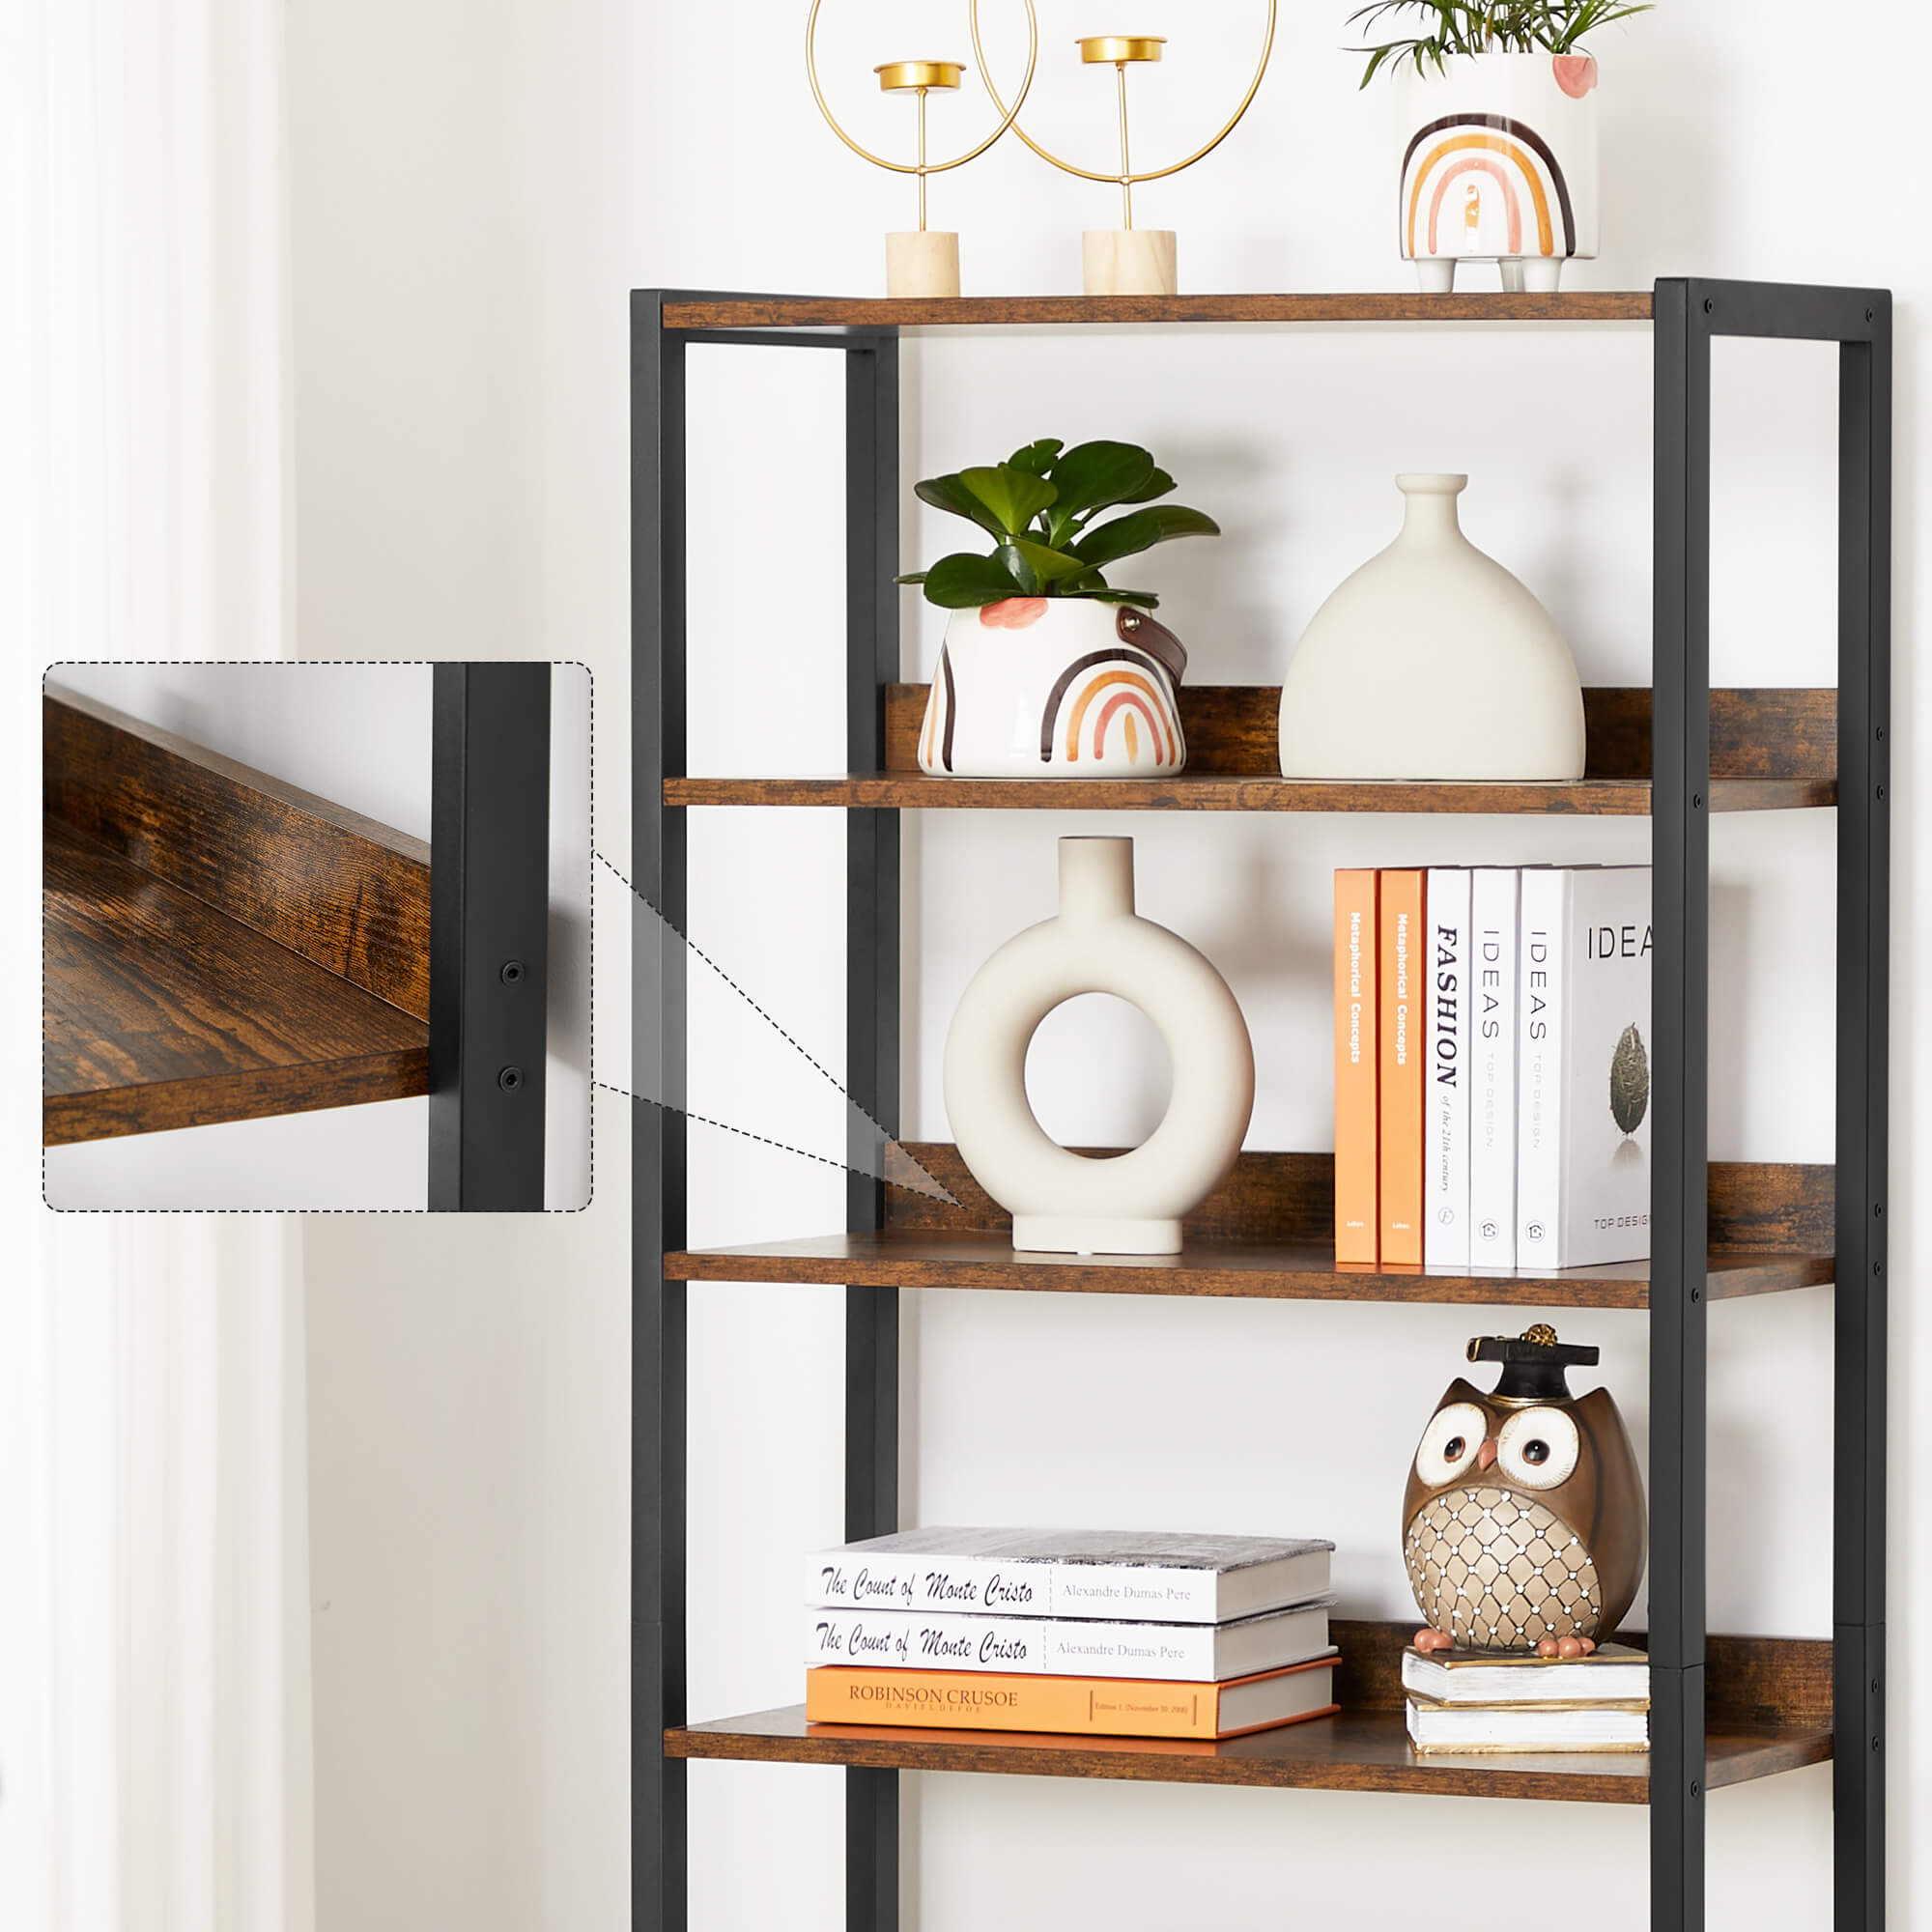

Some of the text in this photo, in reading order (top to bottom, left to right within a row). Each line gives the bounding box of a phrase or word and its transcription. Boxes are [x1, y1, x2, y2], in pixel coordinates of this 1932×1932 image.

[1349, 912, 1361, 1064] Metaphorical Concepts
[1395, 914, 1407, 1065] Metaphorical Concepts
[1436, 924, 1458, 1089] FASHION
[1482, 930, 1500, 1038] IDEAS
[1529, 932, 1547, 1039] IDEAS
[1486, 1052, 1494, 1083] TOP
[1593, 1217, 1614, 1230] TOP
[821, 1567, 1191, 1606] The Count of Monte Cristo Alexandre Dumas Pere
[816, 1622, 1185, 1663] The Count of Monte Cristo Alexandre Dumas Pere
[849, 1685, 1018, 1707] ROBINSON CRUSOE
